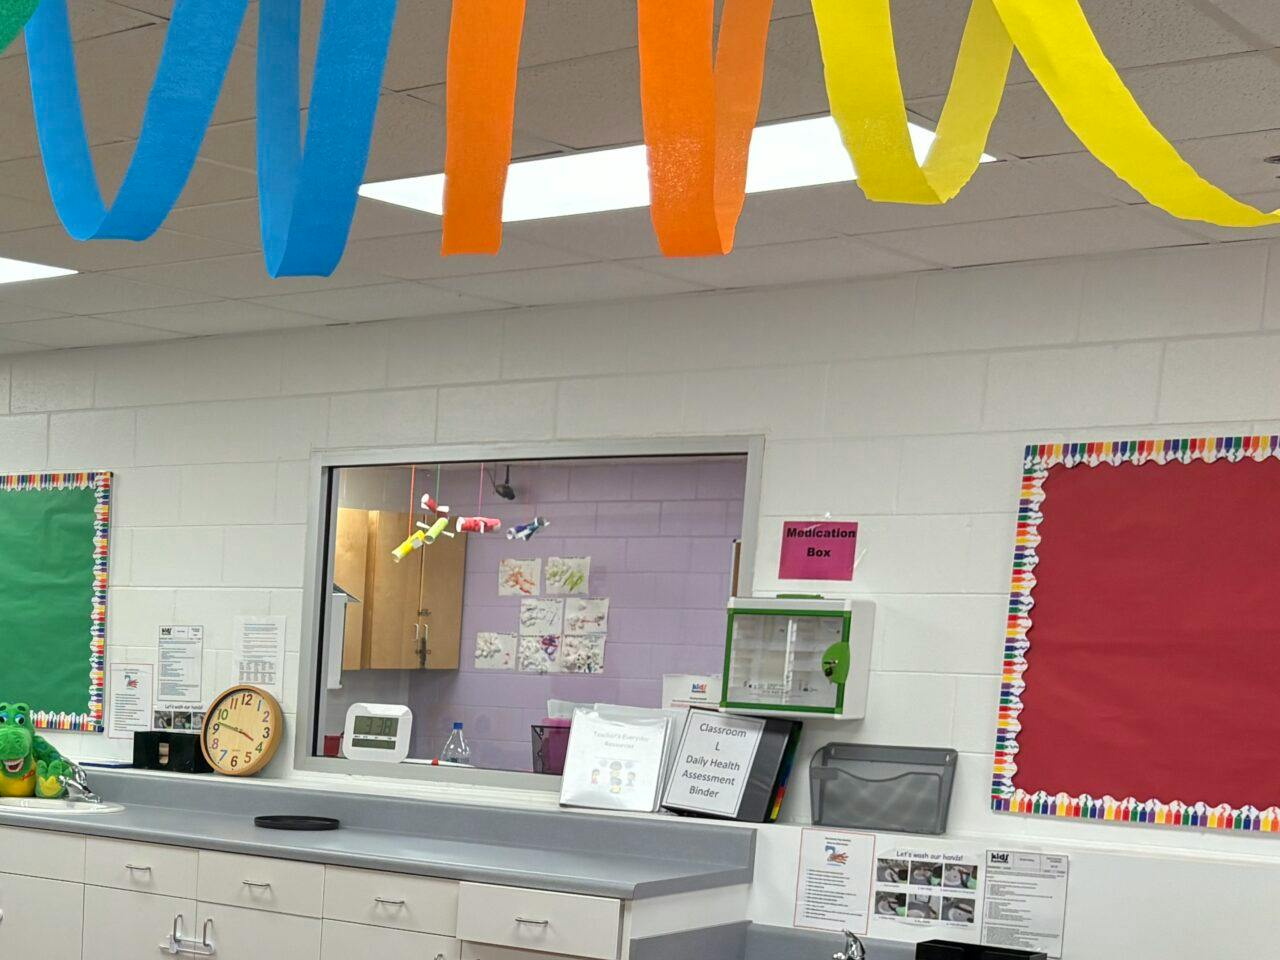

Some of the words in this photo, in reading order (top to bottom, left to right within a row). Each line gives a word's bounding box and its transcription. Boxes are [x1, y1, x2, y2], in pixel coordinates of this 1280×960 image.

[787, 528, 857, 538] Medication
[807, 547, 831, 557] Box
[230, 698, 238, 710] 11
[241, 693, 253, 706] 12
[257, 700, 262, 711] 1
[217, 709, 228, 720] 10
[262, 711, 270, 722] 2
[212, 723, 220, 735] 9
[262, 727, 270, 739] 3
[700, 723, 747, 738] Classroom
[212, 738, 219, 749] 8
[255, 742, 263, 753] 4
[220, 750, 227, 761] 7
[244, 752, 252, 763] 5
[230, 756, 238, 767] 6
[686, 755, 709, 767] Daily
[710, 759, 740, 771] Health
[682, 770, 735, 786] Assessment
[689, 786, 719, 798] Binder
[896, 850, 912, 858] Let's
